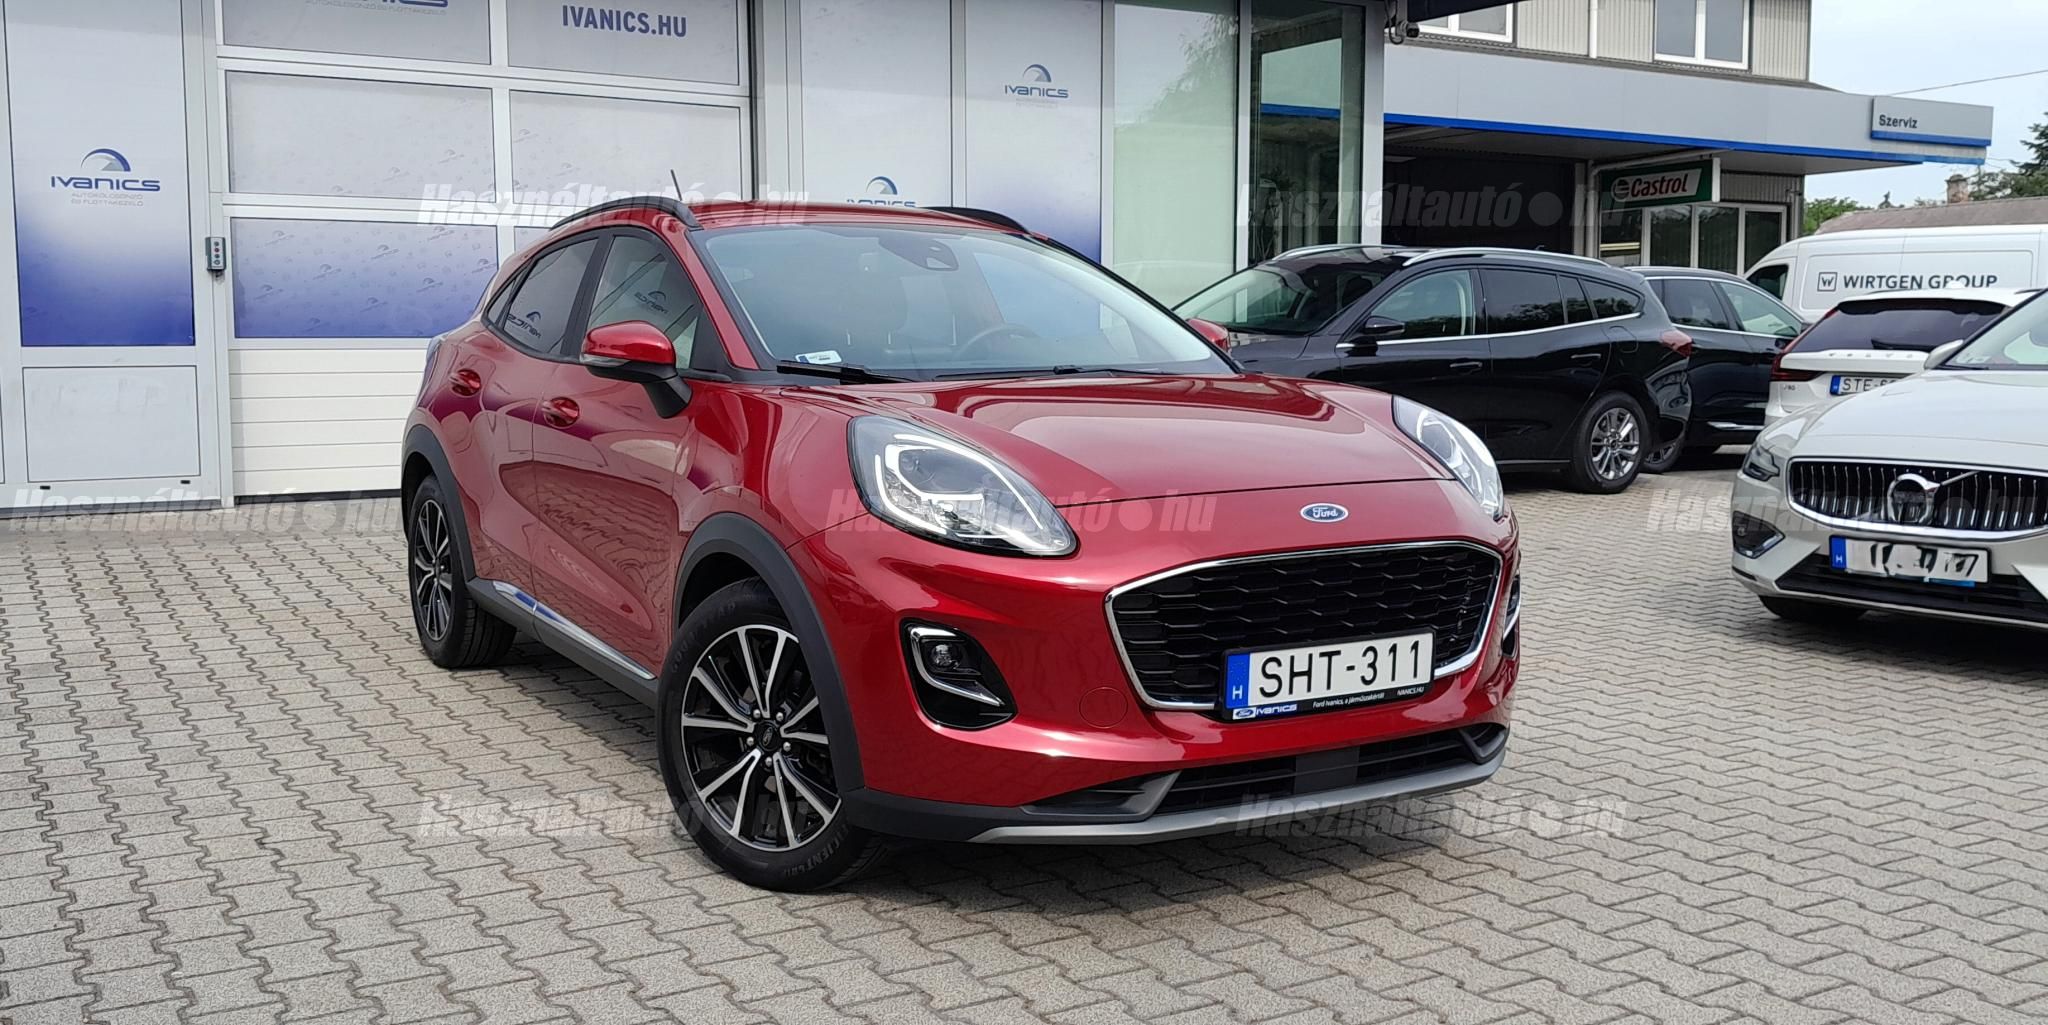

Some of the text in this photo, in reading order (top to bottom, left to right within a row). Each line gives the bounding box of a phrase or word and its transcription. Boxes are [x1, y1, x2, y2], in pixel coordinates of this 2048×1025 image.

[562, 4, 687, 38] IVANICS.HU
[1879, 113, 1918, 129] Szerviz
[1630, 173, 1688, 198] Castrol
[1843, 274, 1924, 289] WIRTGEN
[1232, 640, 1420, 700] H SHT-311
